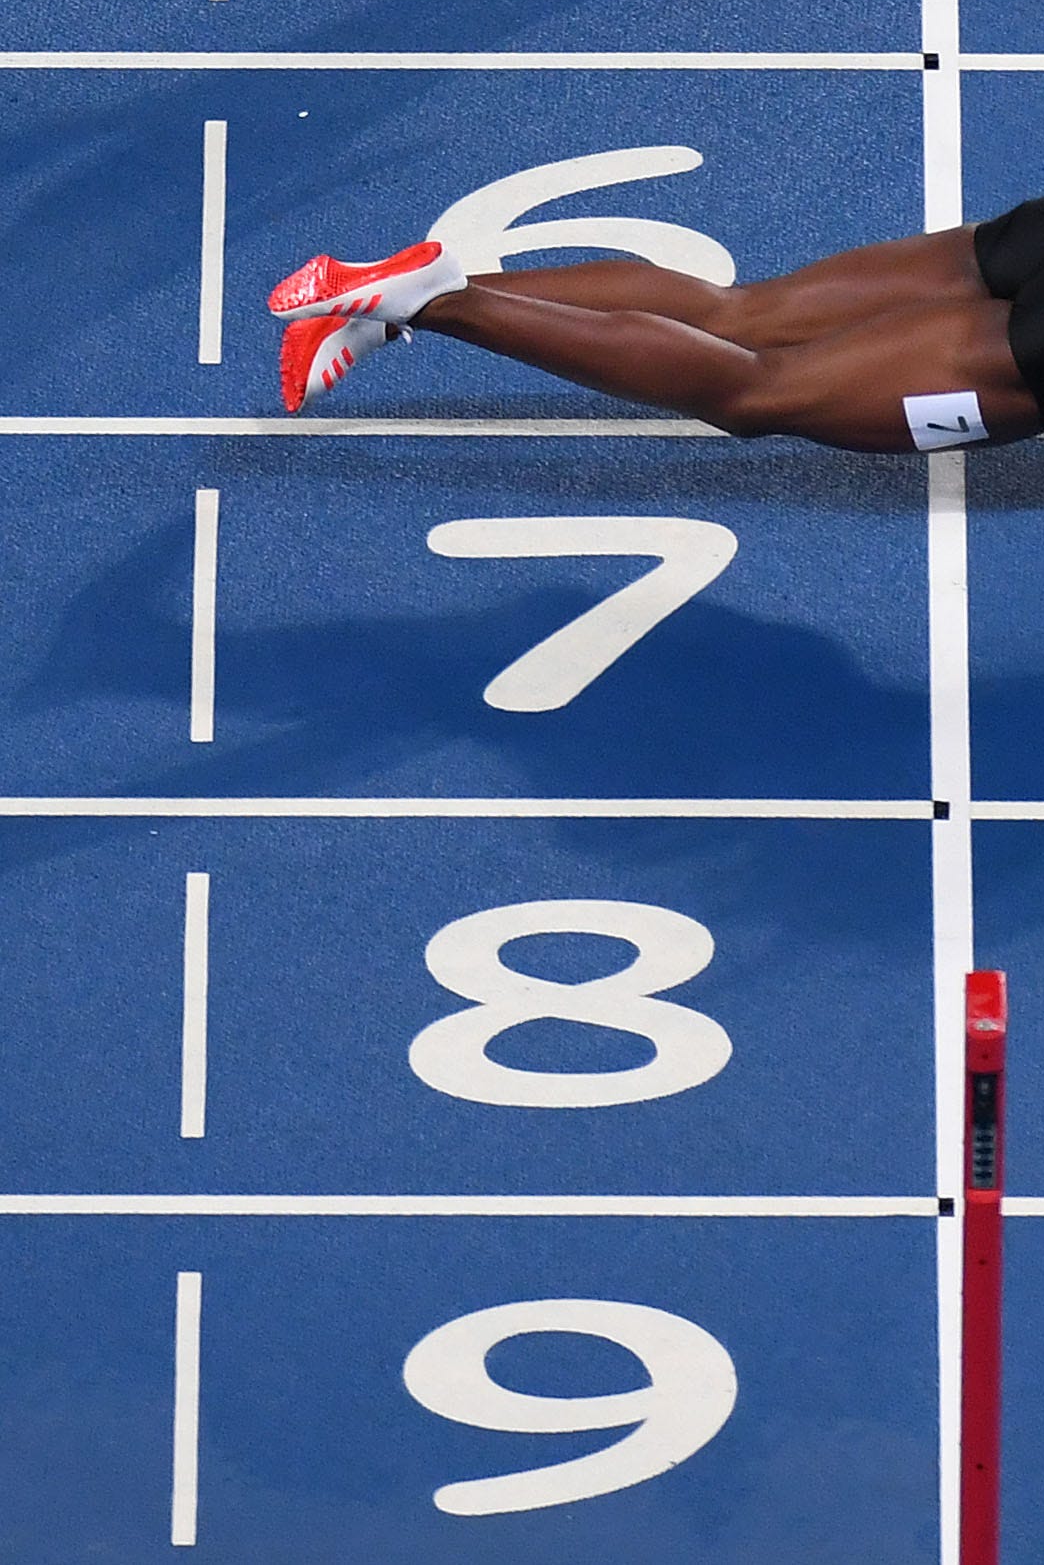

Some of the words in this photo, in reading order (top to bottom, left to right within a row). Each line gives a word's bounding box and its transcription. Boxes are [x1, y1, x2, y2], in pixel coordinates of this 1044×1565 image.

[927, 416, 970, 433] 7
[427, 516, 738, 712] 7
[409, 900, 732, 1108] 8
[403, 1299, 737, 1515] 9
